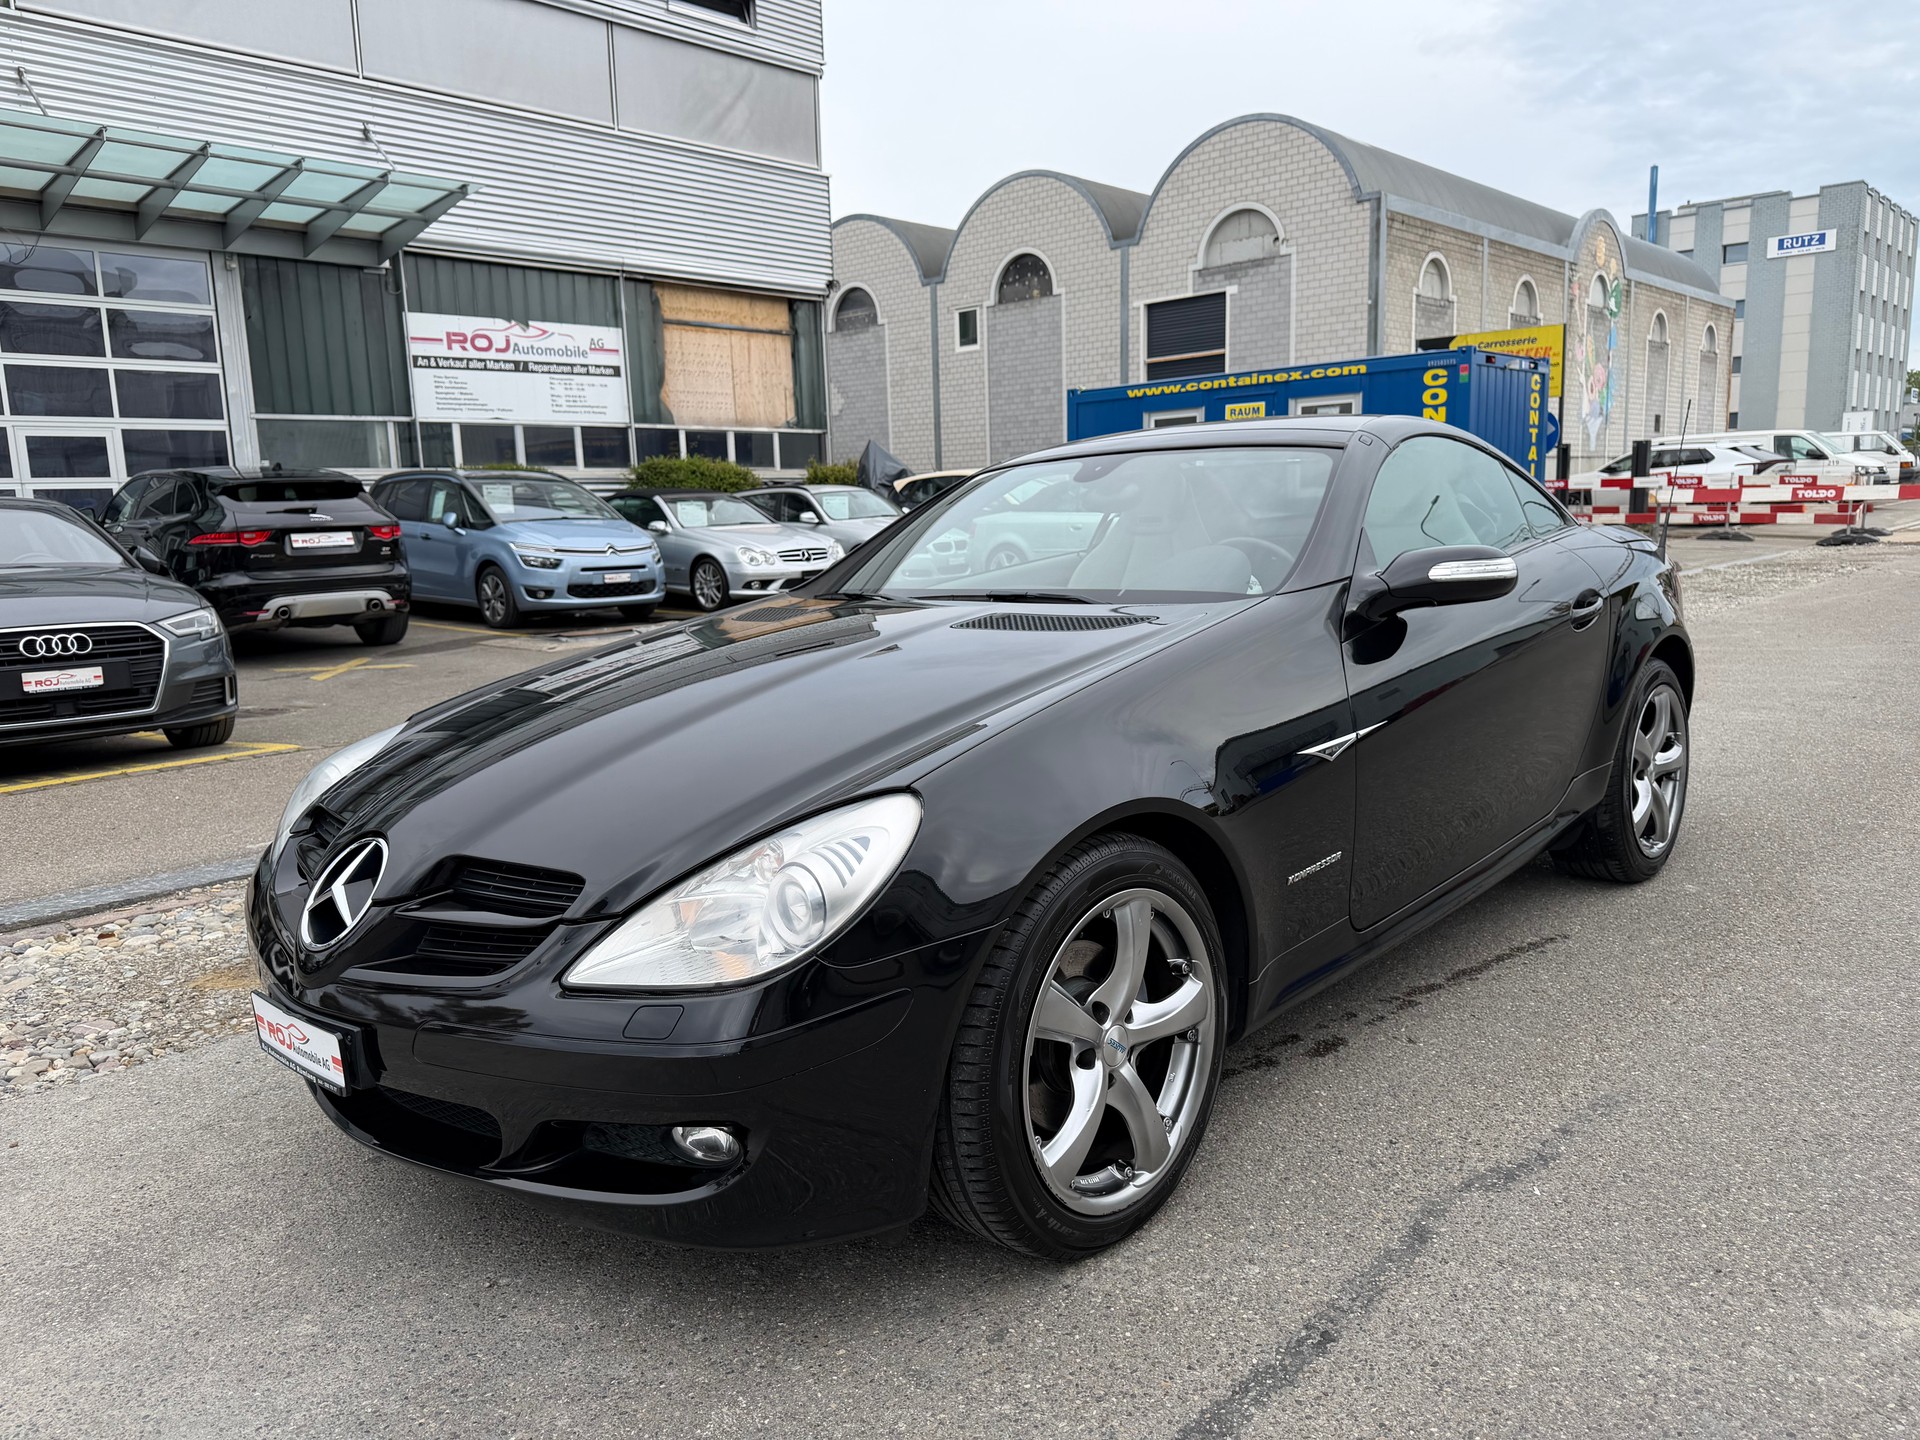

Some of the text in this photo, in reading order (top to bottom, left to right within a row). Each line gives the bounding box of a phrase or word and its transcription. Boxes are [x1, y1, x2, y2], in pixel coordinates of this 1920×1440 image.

[1783, 235, 1820, 249] RUTZ
[446, 331, 604, 358] ROJ Automobile AG
[1477, 336, 1537, 349] Carrosserie
[417, 357, 428, 366] An
[430, 357, 437, 367] &
[437, 358, 468, 368] Verkauf
[468, 359, 485, 369] aller
[486, 360, 515, 370] Marken
[528, 362, 572, 373] Reparaturen
[573, 365, 587, 374] aller
[588, 366, 614, 375] Marken
[1126, 363, 1367, 398] www.containex.com
[1229, 406, 1261, 418] RAUM
[1796, 489, 1836, 498] TOLDO
[35, 679, 59, 687] ROJ
[1286, 851, 1342, 886] KOMPRESSOR
[1164, 868, 1196, 901] YOKOHAMA
[267, 1020, 292, 1050] ROJ
[293, 1042, 321, 1067] Automobile
